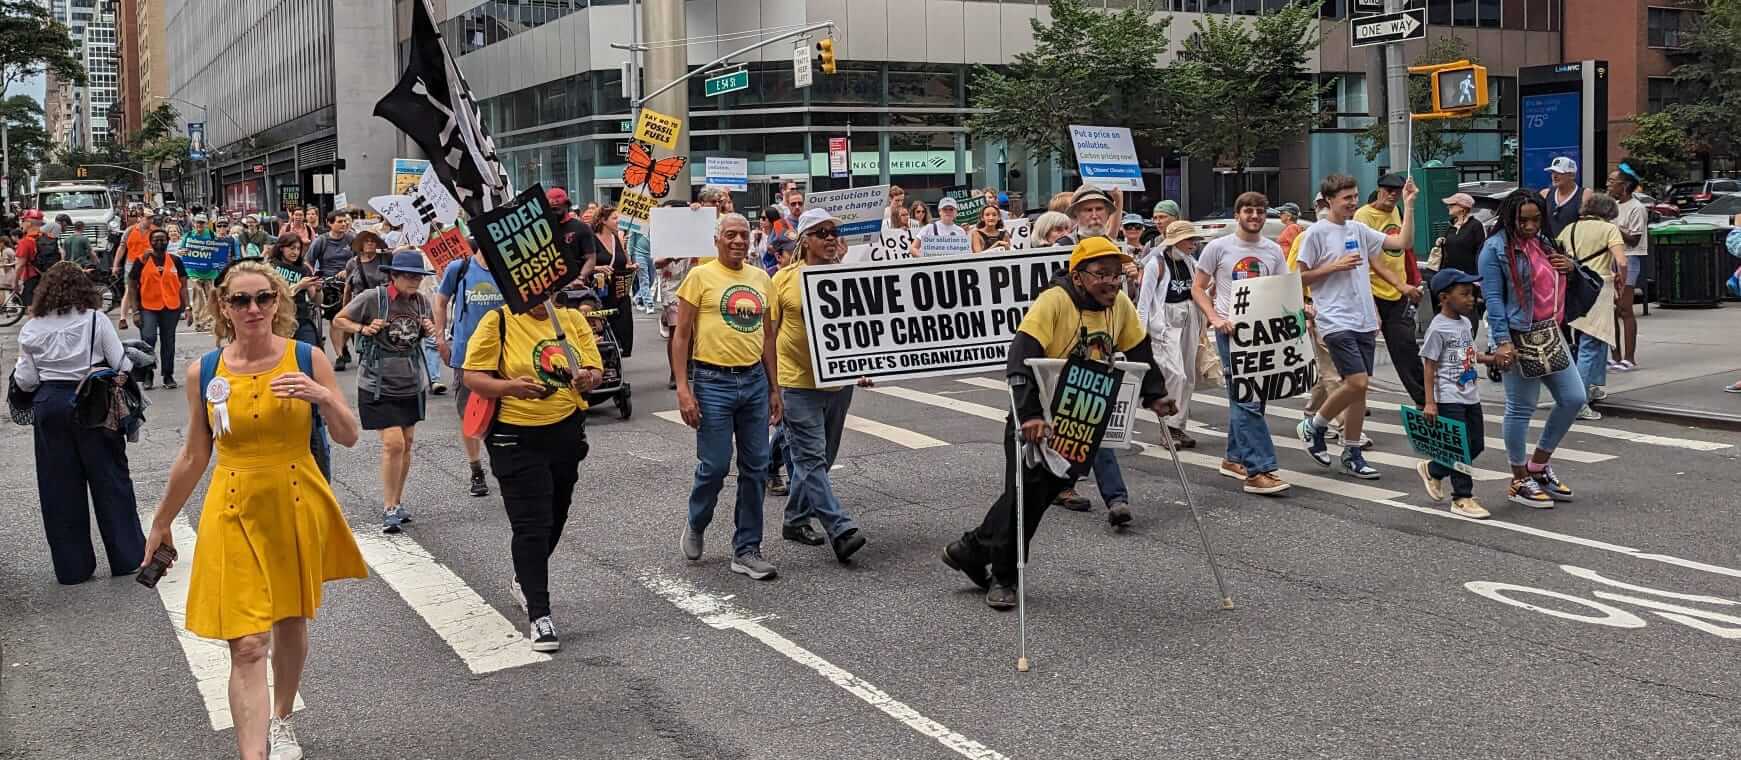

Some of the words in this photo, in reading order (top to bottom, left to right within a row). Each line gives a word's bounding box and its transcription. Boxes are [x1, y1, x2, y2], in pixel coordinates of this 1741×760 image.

[1361, 24, 1381, 37] ONE
[1391, 19, 1413, 33] WAY
[716, 80, 721, 90] E
[721, 79, 729, 89] 54
[644, 113, 658, 121] SAY
[645, 121, 673, 136] FOSSIL
[643, 130, 671, 143] FUELS
[891, 160, 926, 169] MERICA
[810, 196, 827, 204] Our
[830, 191, 869, 202] solution
[845, 199, 883, 210] change?
[487, 197, 544, 243] BIDEN
[622, 206, 650, 221] FUELS
[431, 235, 460, 257] BIDEN
[497, 218, 553, 269] END
[510, 244, 561, 285] FOSSIL
[518, 258, 568, 302] FUELS
[817, 274, 905, 320] SAVE
[910, 268, 982, 312] OUR
[988, 260, 1071, 304] PLA
[1233, 286, 1250, 315] #
[822, 319, 885, 352] STOP
[891, 311, 987, 346] CARBON
[994, 306, 1030, 337] PO
[829, 353, 898, 375] PEOPLE'S
[901, 345, 1006, 369] ORGANIZATION
[1231, 349, 1275, 376] FEE
[1283, 346, 1304, 367] &
[1066, 364, 1115, 398] BIDEN
[1056, 385, 1107, 425] END
[1053, 415, 1097, 444] FOSSIL
[1408, 422, 1463, 449] POWER
[1053, 435, 1090, 463] UELS
